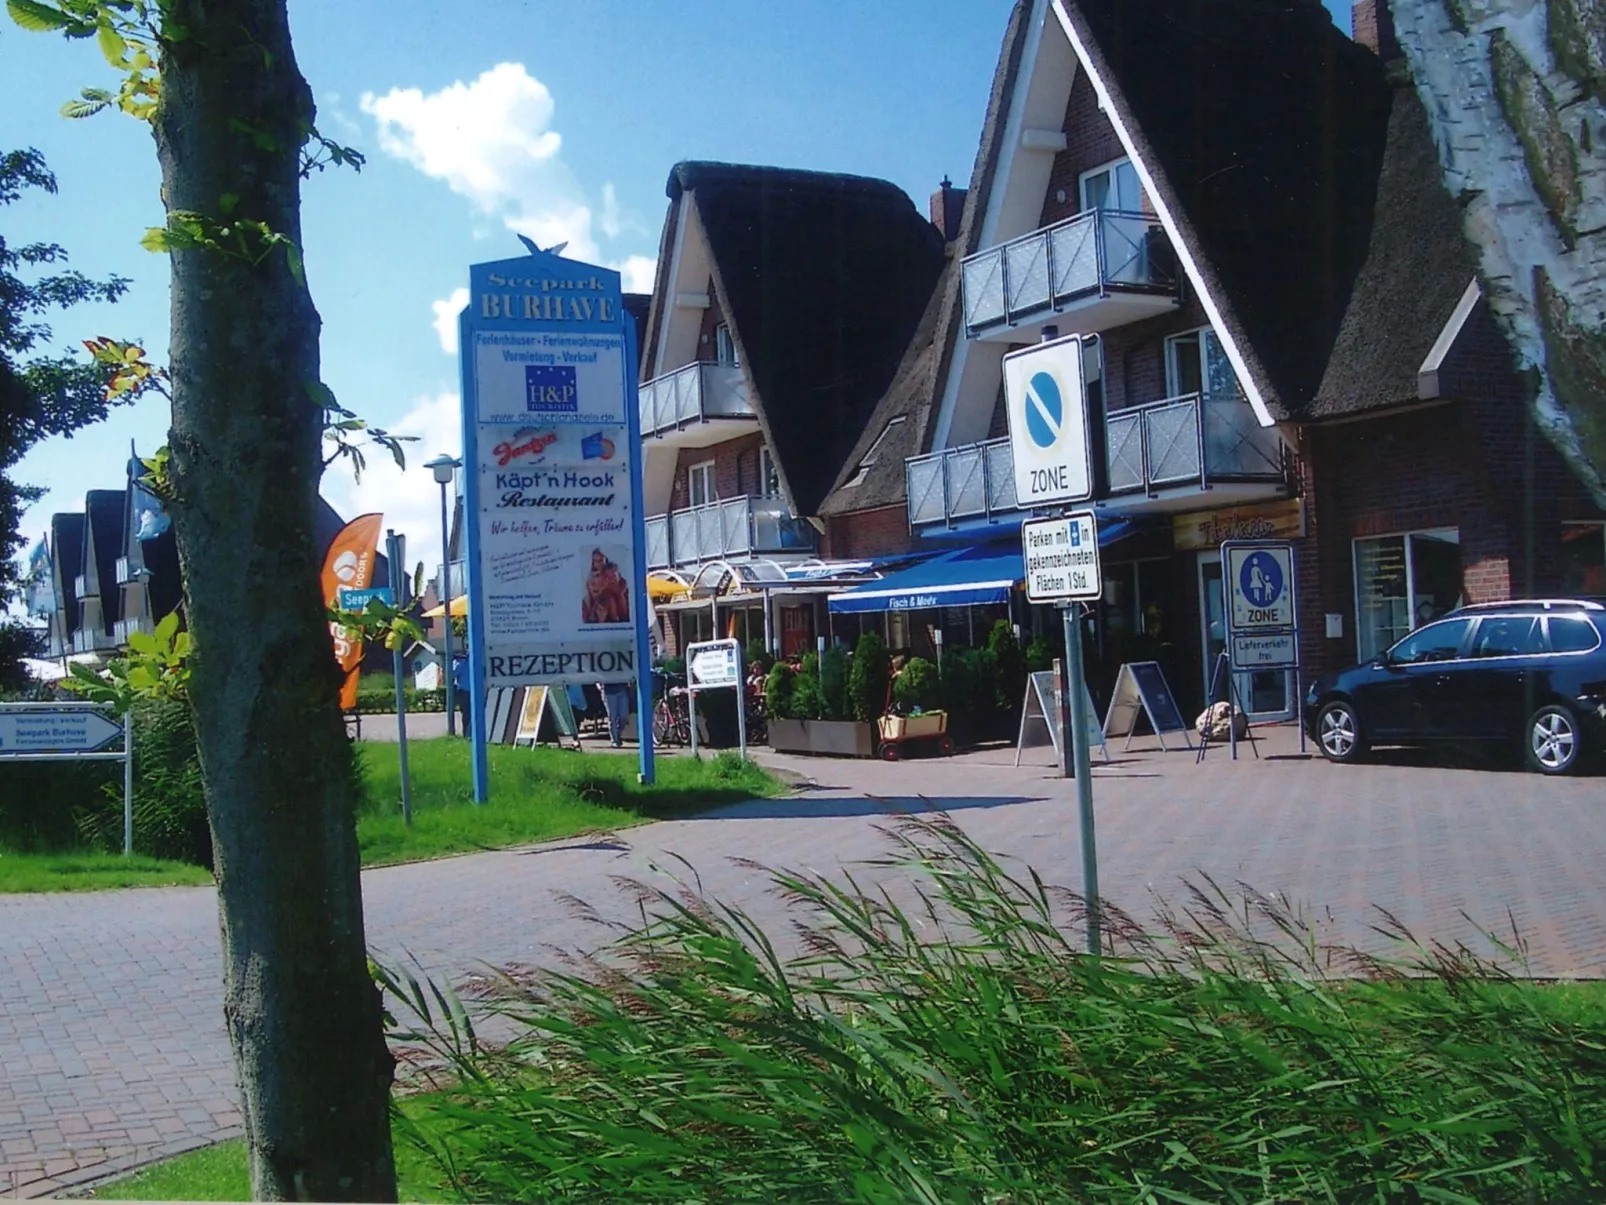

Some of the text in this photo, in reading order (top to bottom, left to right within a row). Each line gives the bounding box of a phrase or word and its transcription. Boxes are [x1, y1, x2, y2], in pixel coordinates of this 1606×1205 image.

[488, 273, 605, 292] Seepark
[481, 293, 616, 321] BURHAVE
[502, 350, 555, 365] Vermietung
[562, 351, 598, 363] Verkauf
[530, 384, 575, 403] H&P
[564, 472, 614, 488] Hook
[1031, 465, 1069, 494] ZONE
[496, 492, 615, 508] Restaurant
[1029, 524, 1090, 548] Parken mit in
[1029, 549, 1094, 575] gekennzeichneten
[1036, 573, 1065, 592] Flächen
[909, 596, 916, 607] &
[1248, 608, 1280, 623] ZONE
[1239, 639, 1289, 650] Lieferverkehr
[489, 650, 634, 677] REZEPTION
[1259, 651, 1272, 661] frei
